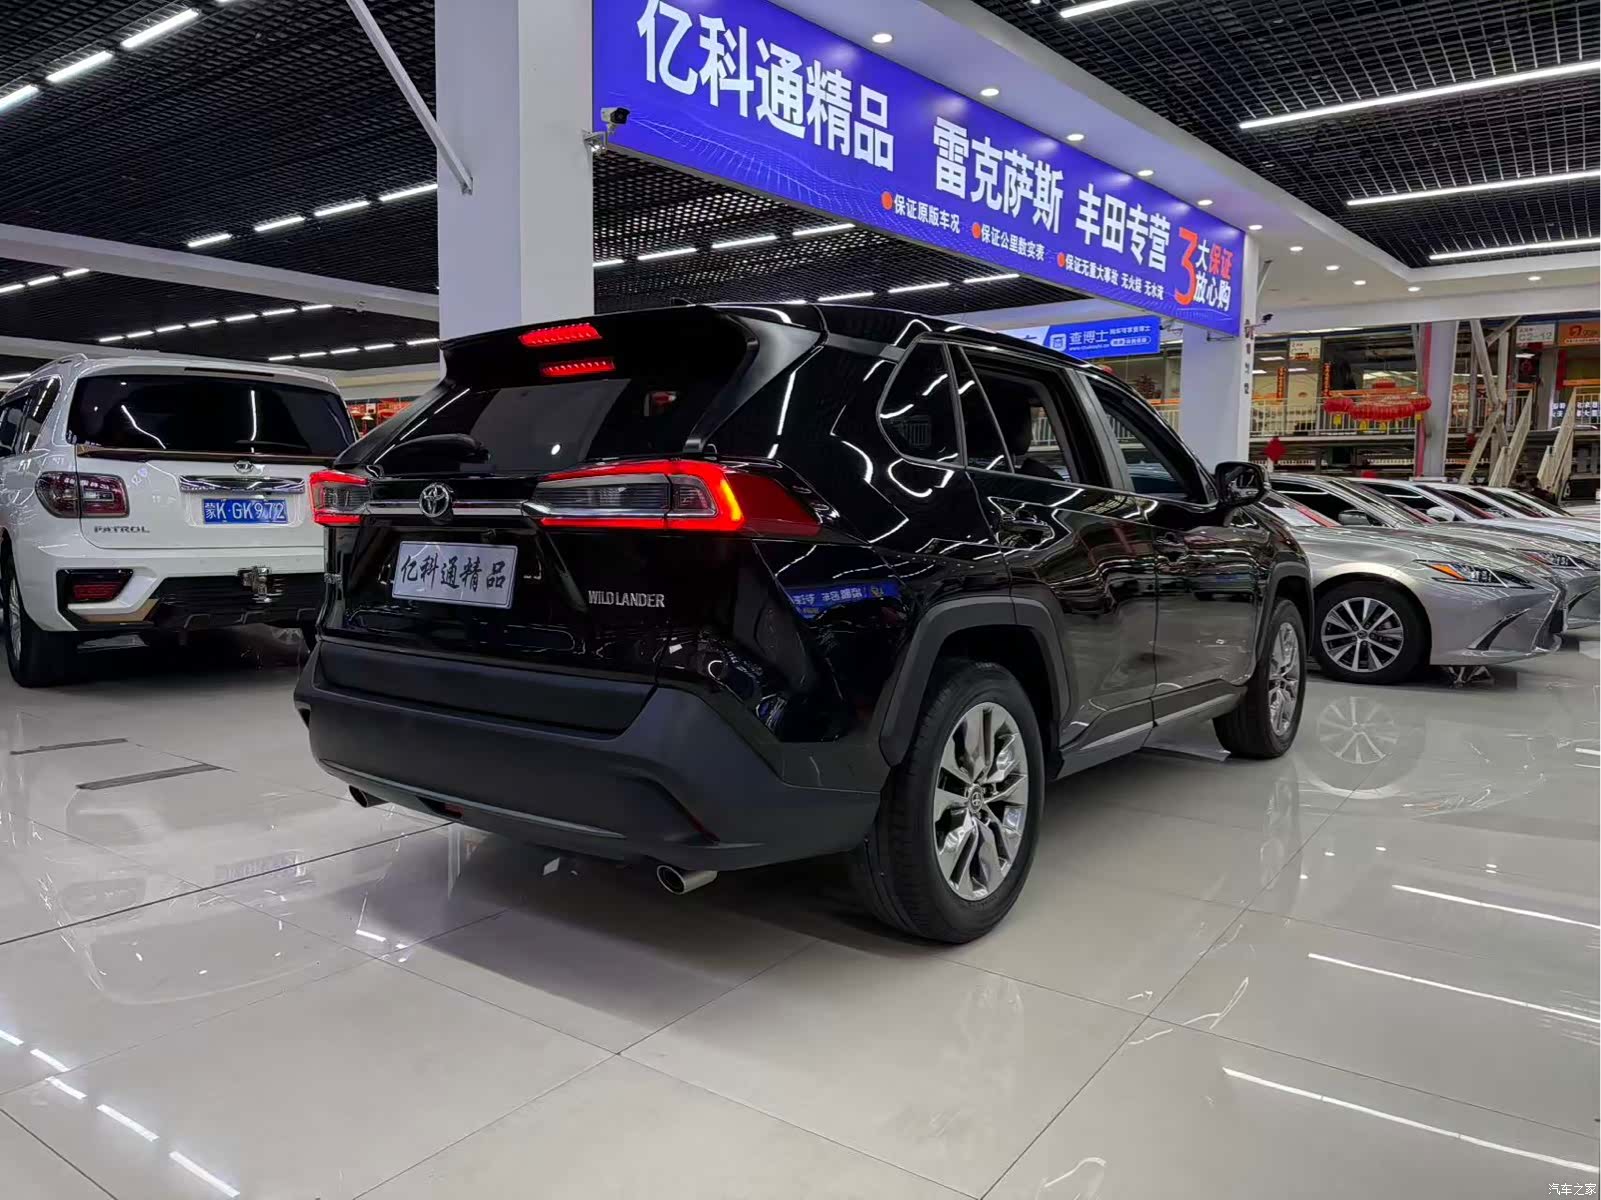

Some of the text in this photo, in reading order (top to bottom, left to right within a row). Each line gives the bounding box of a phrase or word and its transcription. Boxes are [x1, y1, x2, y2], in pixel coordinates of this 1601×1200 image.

[637, 0, 894, 172] 亿科通精品
[894, 194, 961, 234] 保证原版车况
[933, 116, 1171, 273] 雷克萨斯 丰田专营
[1193, 270, 1231, 312] 放心购
[1069, 330, 1109, 345] 查博士
[93, 525, 150, 534] PATROL
[401, 553, 506, 592] 亿科通精品
